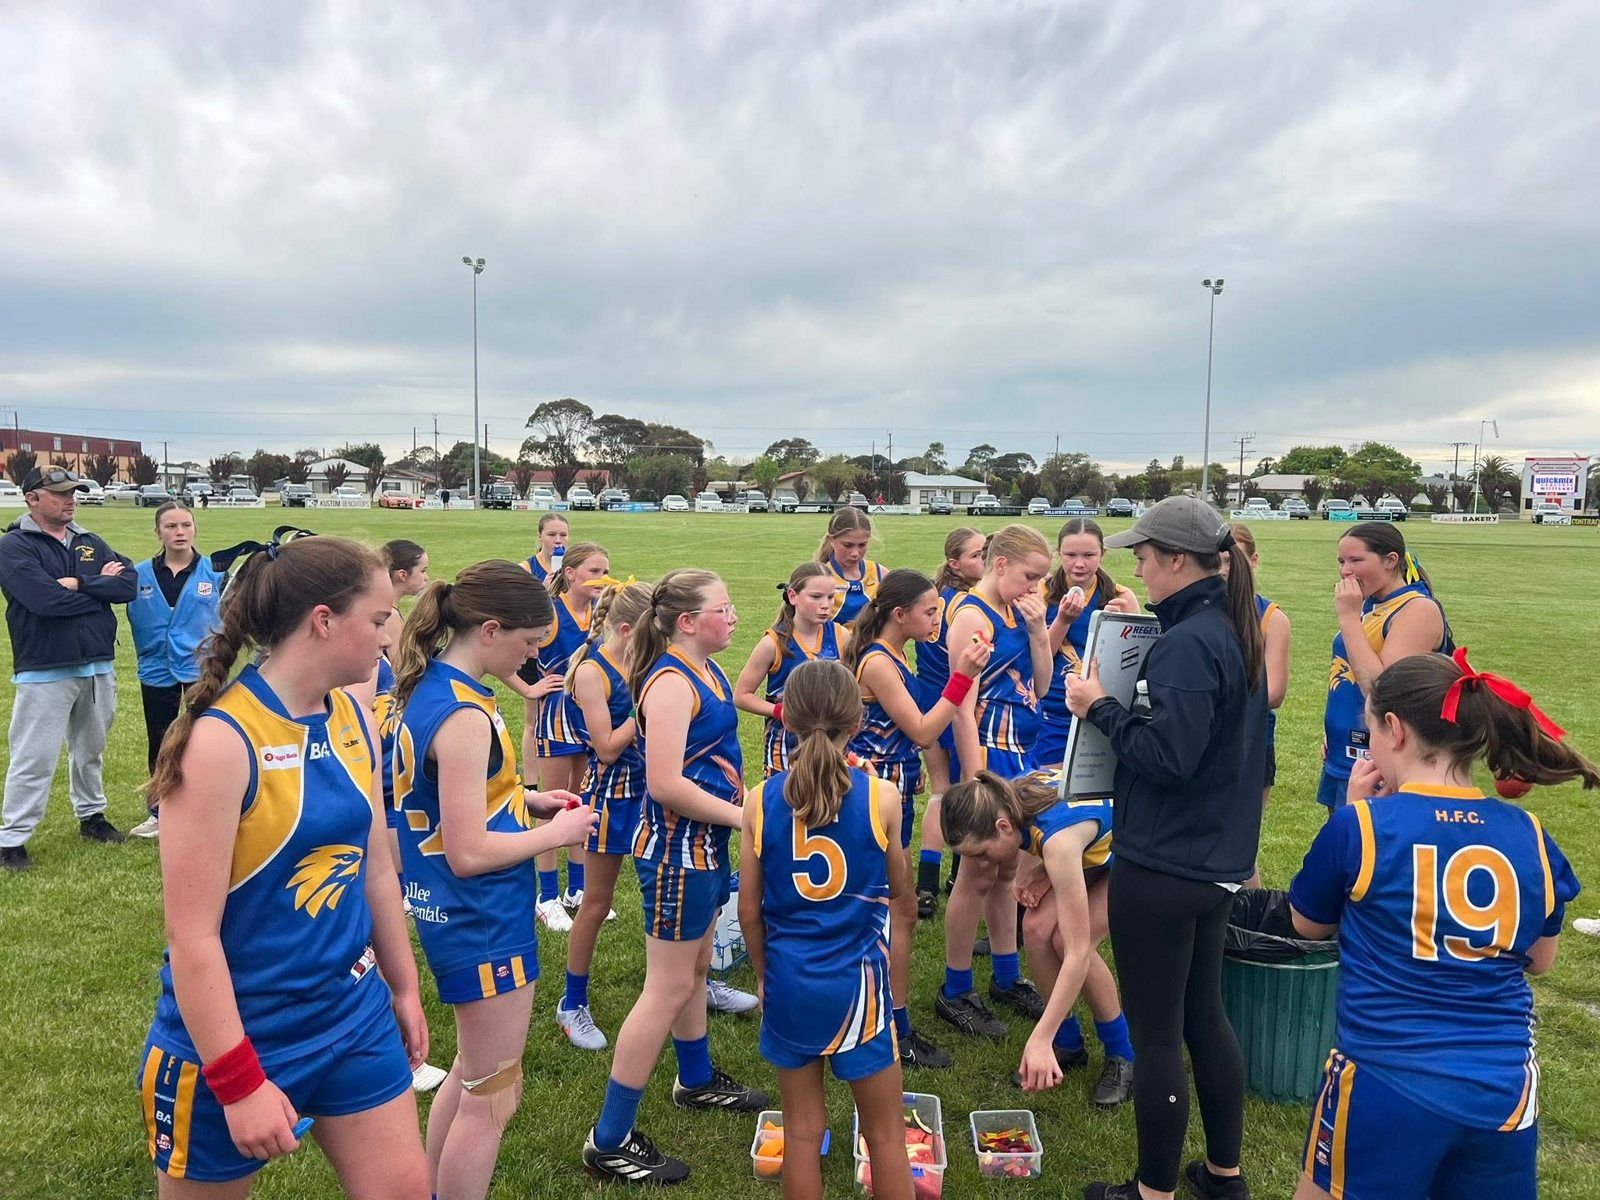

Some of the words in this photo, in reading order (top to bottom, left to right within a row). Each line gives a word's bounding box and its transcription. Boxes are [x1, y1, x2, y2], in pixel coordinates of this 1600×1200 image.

[792, 806, 848, 902] 5
[1435, 810, 1485, 824] H.F.C.
[1411, 844, 1521, 962] 19
